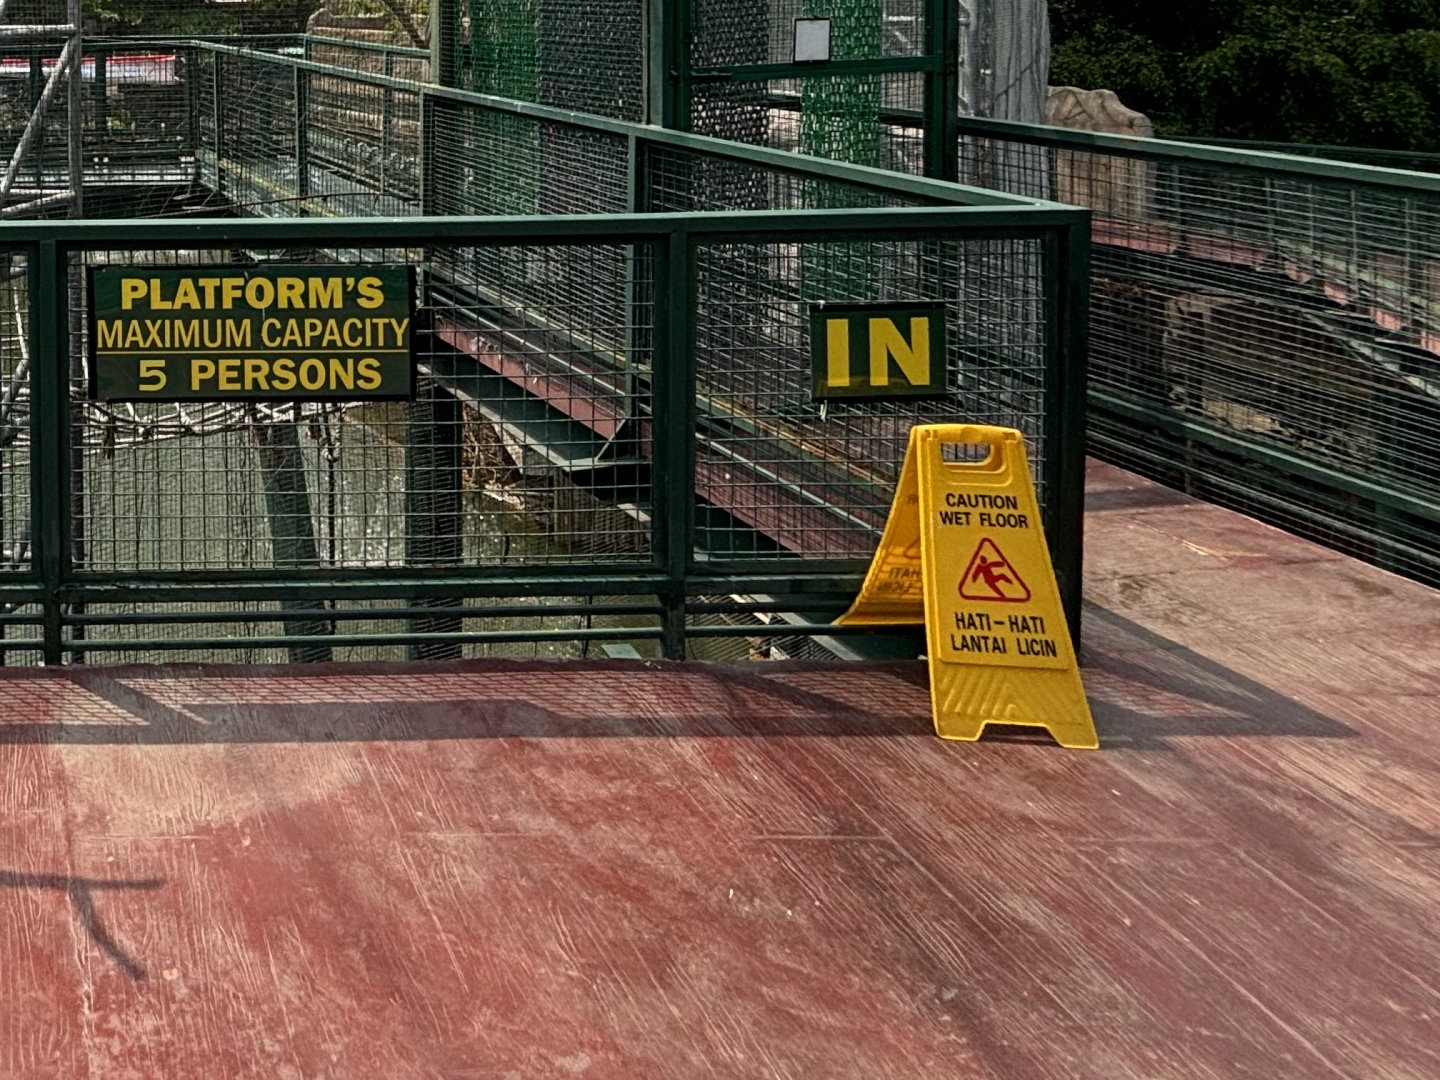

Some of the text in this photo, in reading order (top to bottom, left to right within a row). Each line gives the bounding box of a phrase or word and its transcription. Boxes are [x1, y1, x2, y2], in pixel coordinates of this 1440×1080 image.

[121, 276, 384, 311] PLATFORM'S
[97, 317, 409, 349] MAXIMUM CAPACITY
[826, 316, 931, 387] IN
[139, 358, 383, 391] 5 PERSONS
[945, 493, 1018, 510] CAUTION
[940, 511, 1029, 529] WET FLOOR
[951, 634, 1058, 658] LANTAI LICIN
